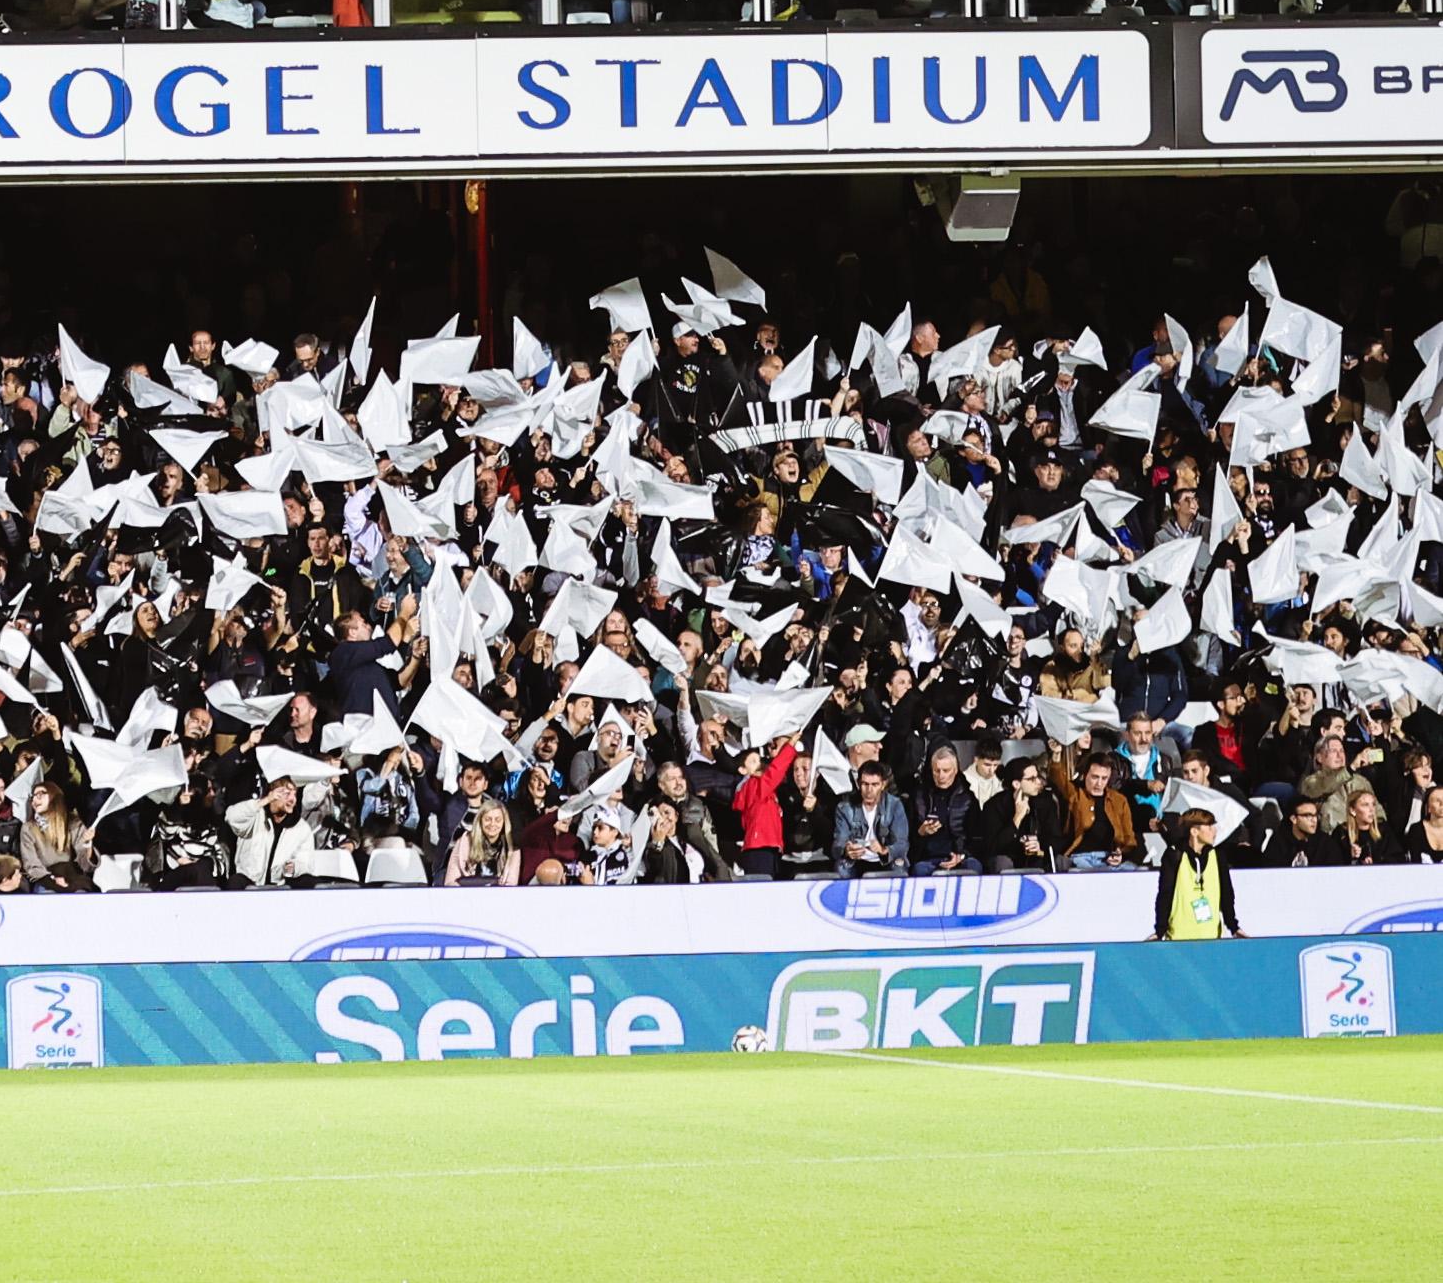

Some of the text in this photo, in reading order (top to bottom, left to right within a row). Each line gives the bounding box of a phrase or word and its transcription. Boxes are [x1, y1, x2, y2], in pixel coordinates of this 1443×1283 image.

[517, 53, 1102, 133] STADIUM
[315, 975, 685, 1064] Serie
[783, 983, 1071, 1051] BKT
